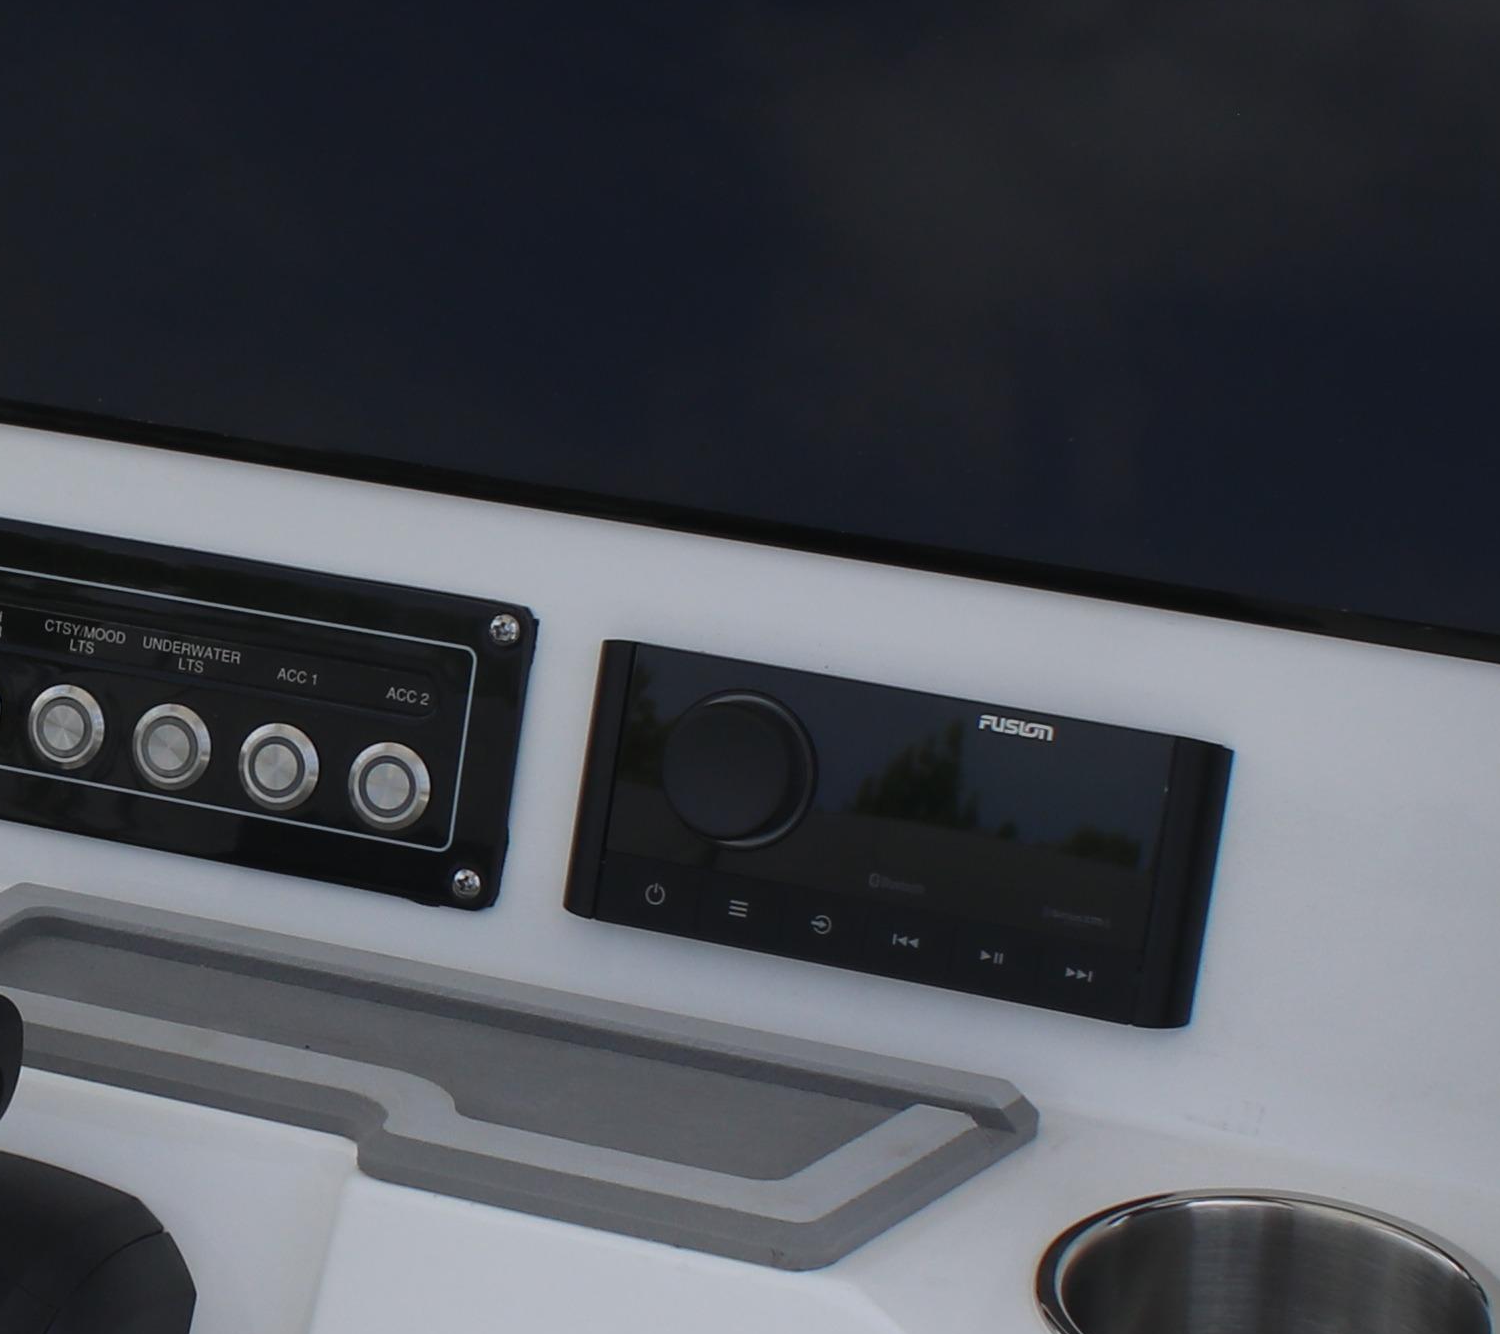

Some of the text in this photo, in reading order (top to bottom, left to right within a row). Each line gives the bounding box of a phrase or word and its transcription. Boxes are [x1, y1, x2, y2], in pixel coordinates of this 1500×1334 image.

[44, 619, 127, 646] CTSY/MOOD
[69, 638, 95, 655] LTS
[142, 635, 241, 666] UNDERWATER
[178, 657, 204, 674] LTS
[276, 667, 318, 686] ACC 1
[385, 686, 430, 706] ACC 2
[978, 712, 1056, 741] FUSION
